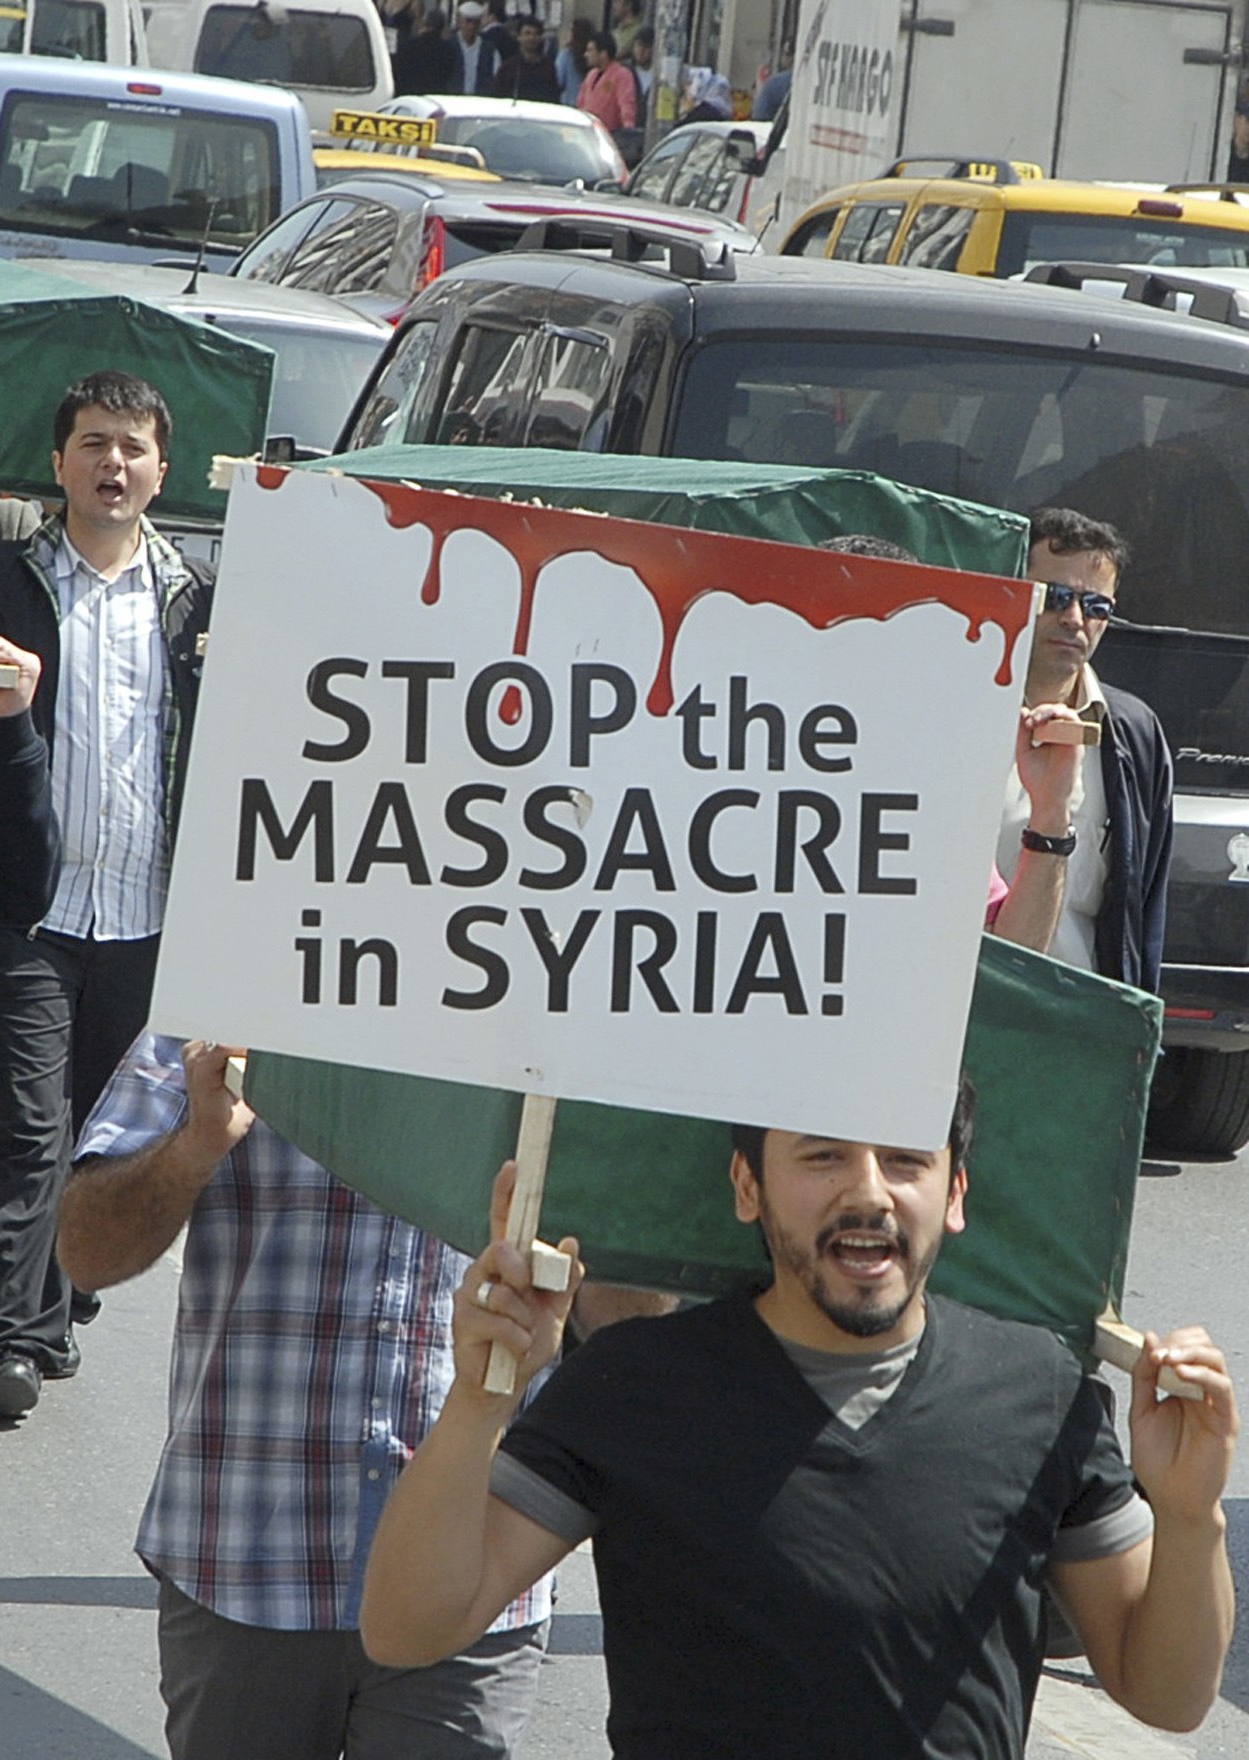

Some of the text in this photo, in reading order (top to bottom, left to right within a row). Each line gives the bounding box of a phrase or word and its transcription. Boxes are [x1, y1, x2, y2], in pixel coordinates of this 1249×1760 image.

[302, 657, 858, 773] STOP the
[235, 778, 919, 896] MASSACRE
[295, 905, 847, 1017] in SYRIA!
